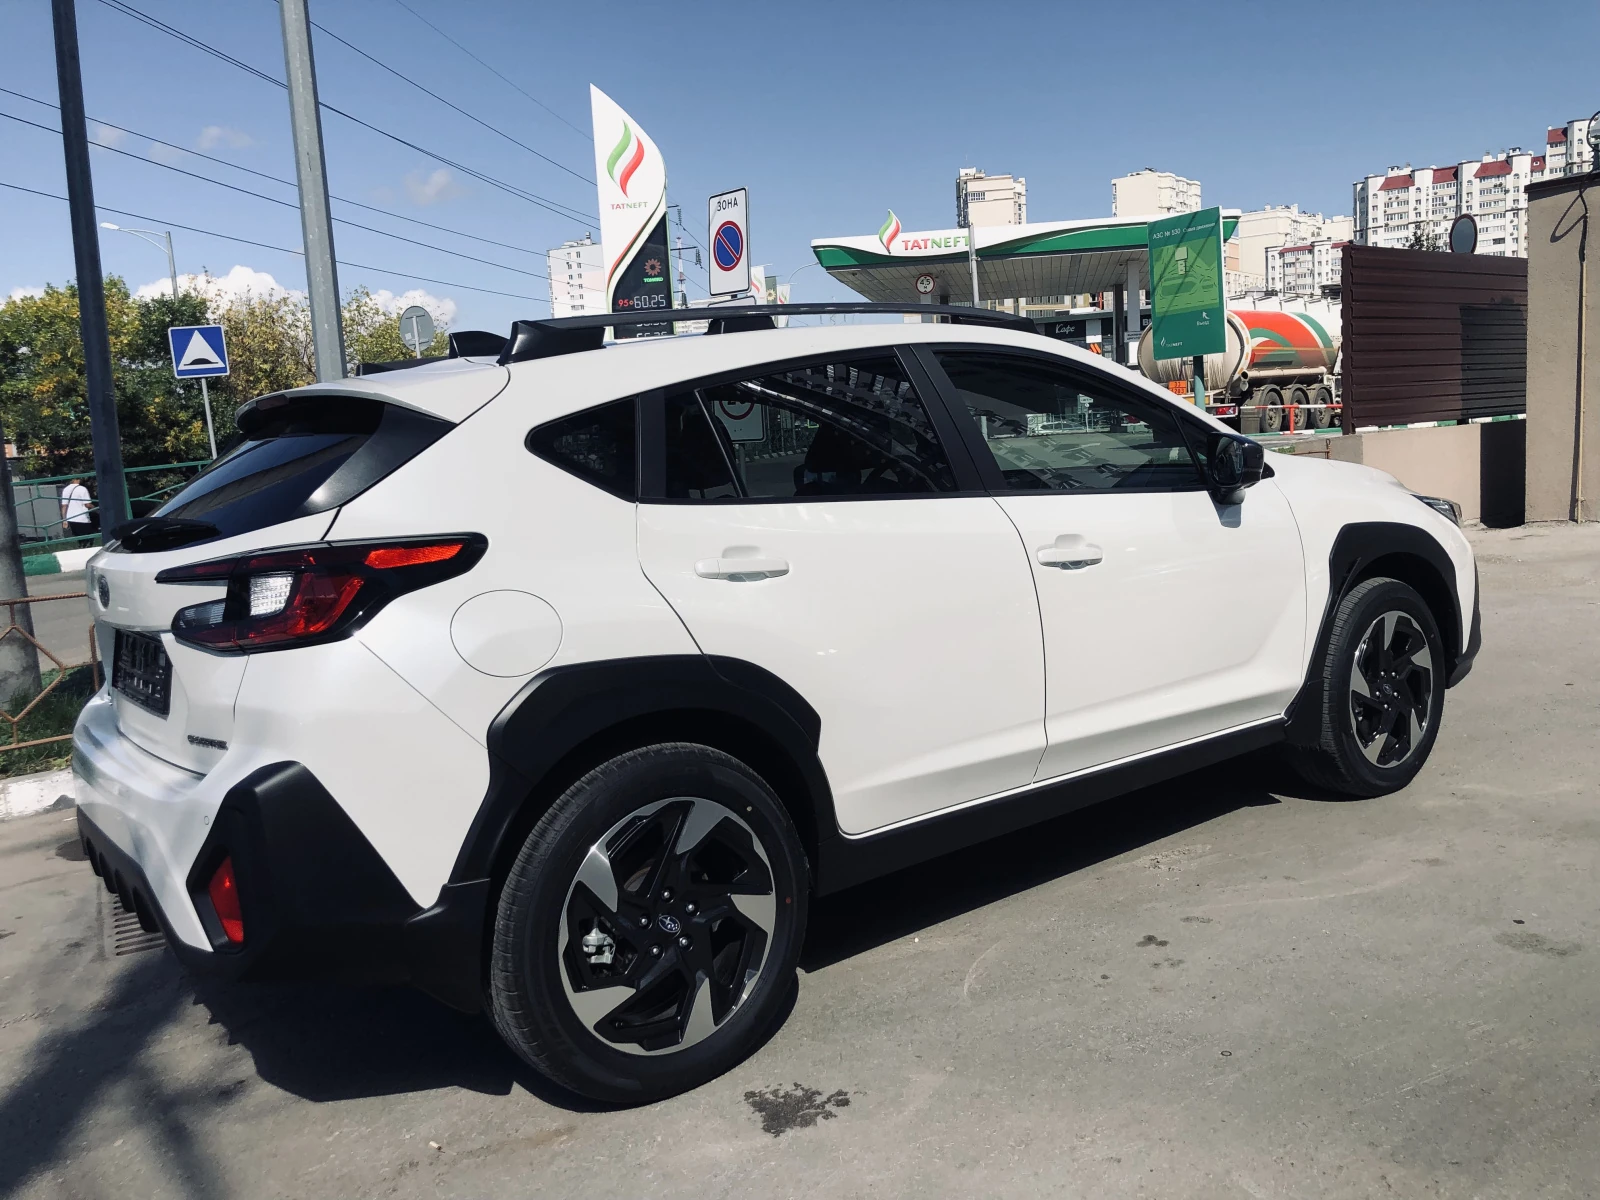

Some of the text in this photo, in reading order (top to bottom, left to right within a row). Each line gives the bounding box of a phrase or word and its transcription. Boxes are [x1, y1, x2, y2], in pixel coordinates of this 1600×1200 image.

[610, 201, 648, 210] TATNEFT
[716, 197, 739, 212] ЗОНА
[1152, 231, 1164, 240] АЗС
[902, 236, 969, 251] TATNEFT
[618, 294, 666, 309] 95 60.25
[1055, 323, 1076, 335] Кафе
